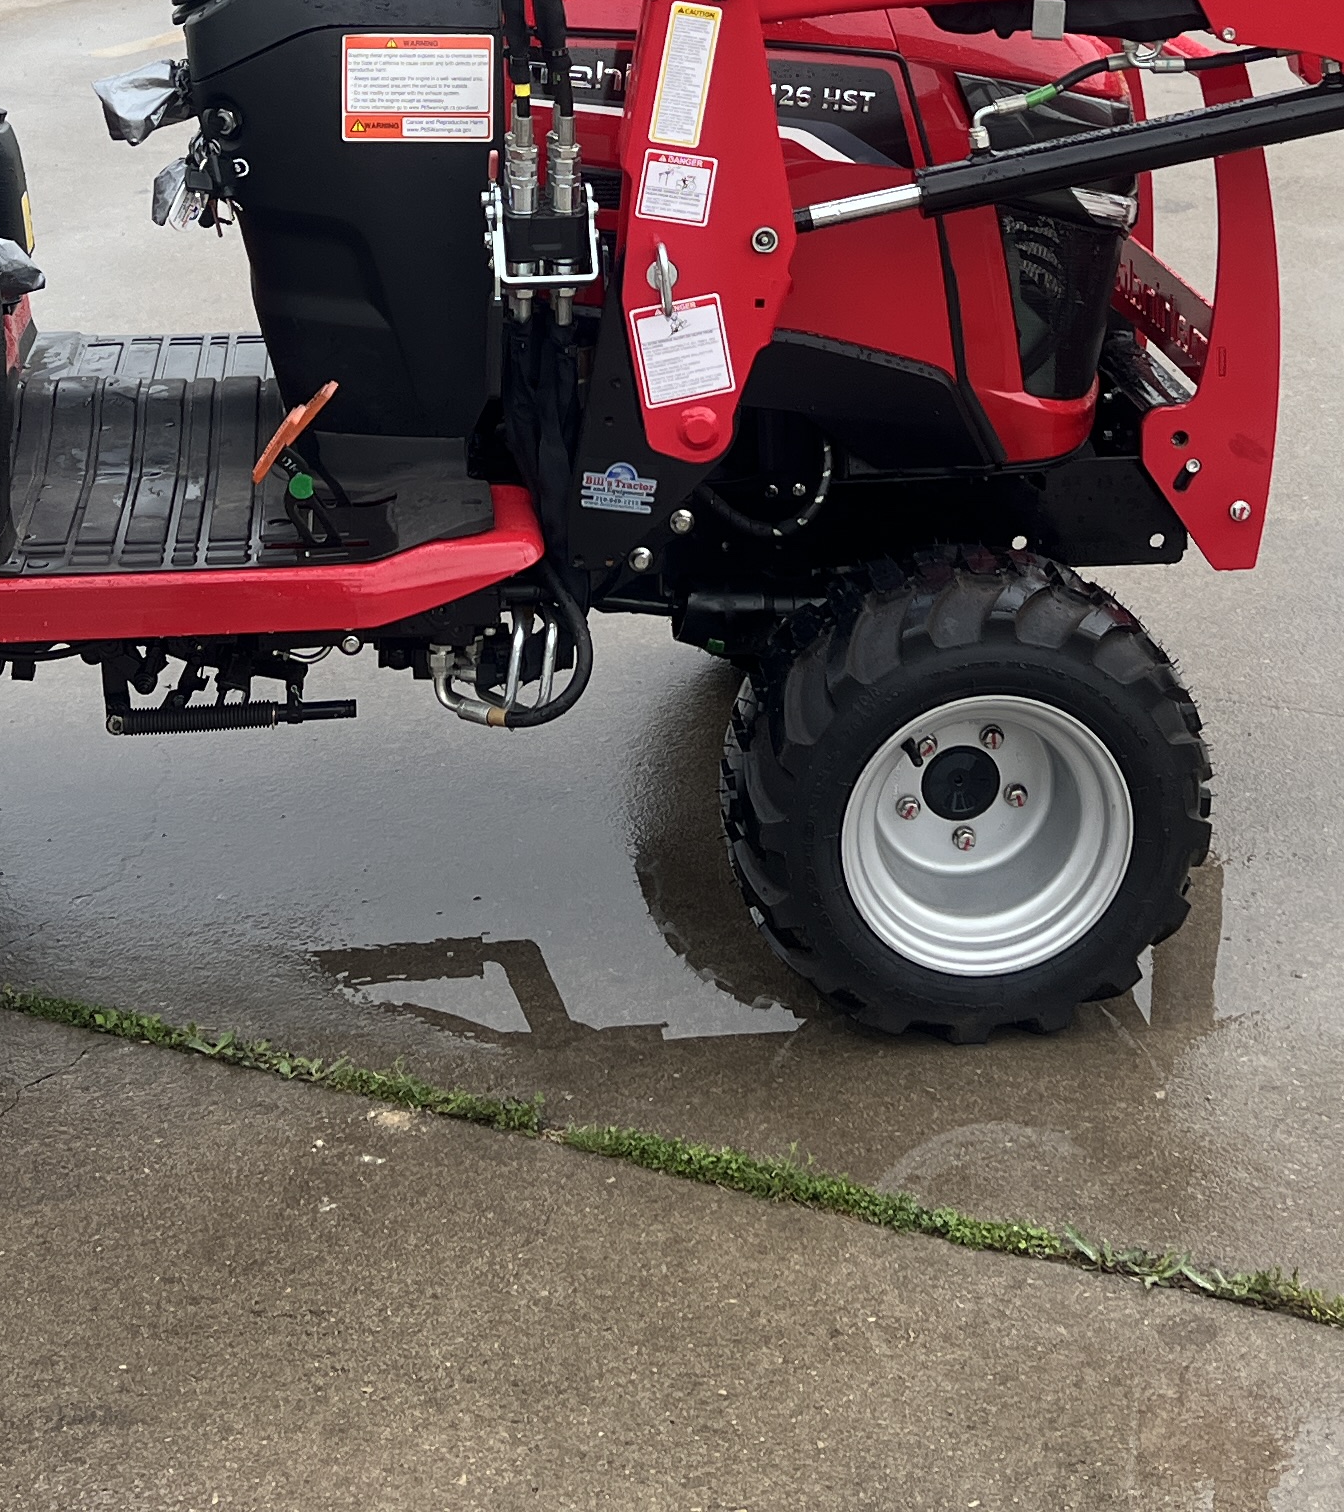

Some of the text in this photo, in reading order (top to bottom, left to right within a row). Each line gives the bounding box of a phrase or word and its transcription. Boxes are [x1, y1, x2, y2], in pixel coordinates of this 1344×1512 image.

[685, 8, 716, 18] CAUTION
[403, 39, 439, 47] WARNING
[821, 87, 876, 113] HST
[365, 122, 400, 130] WARNING
[667, 155, 704, 168] DANGER
[585, 475, 654, 492] Bill's Tractor
